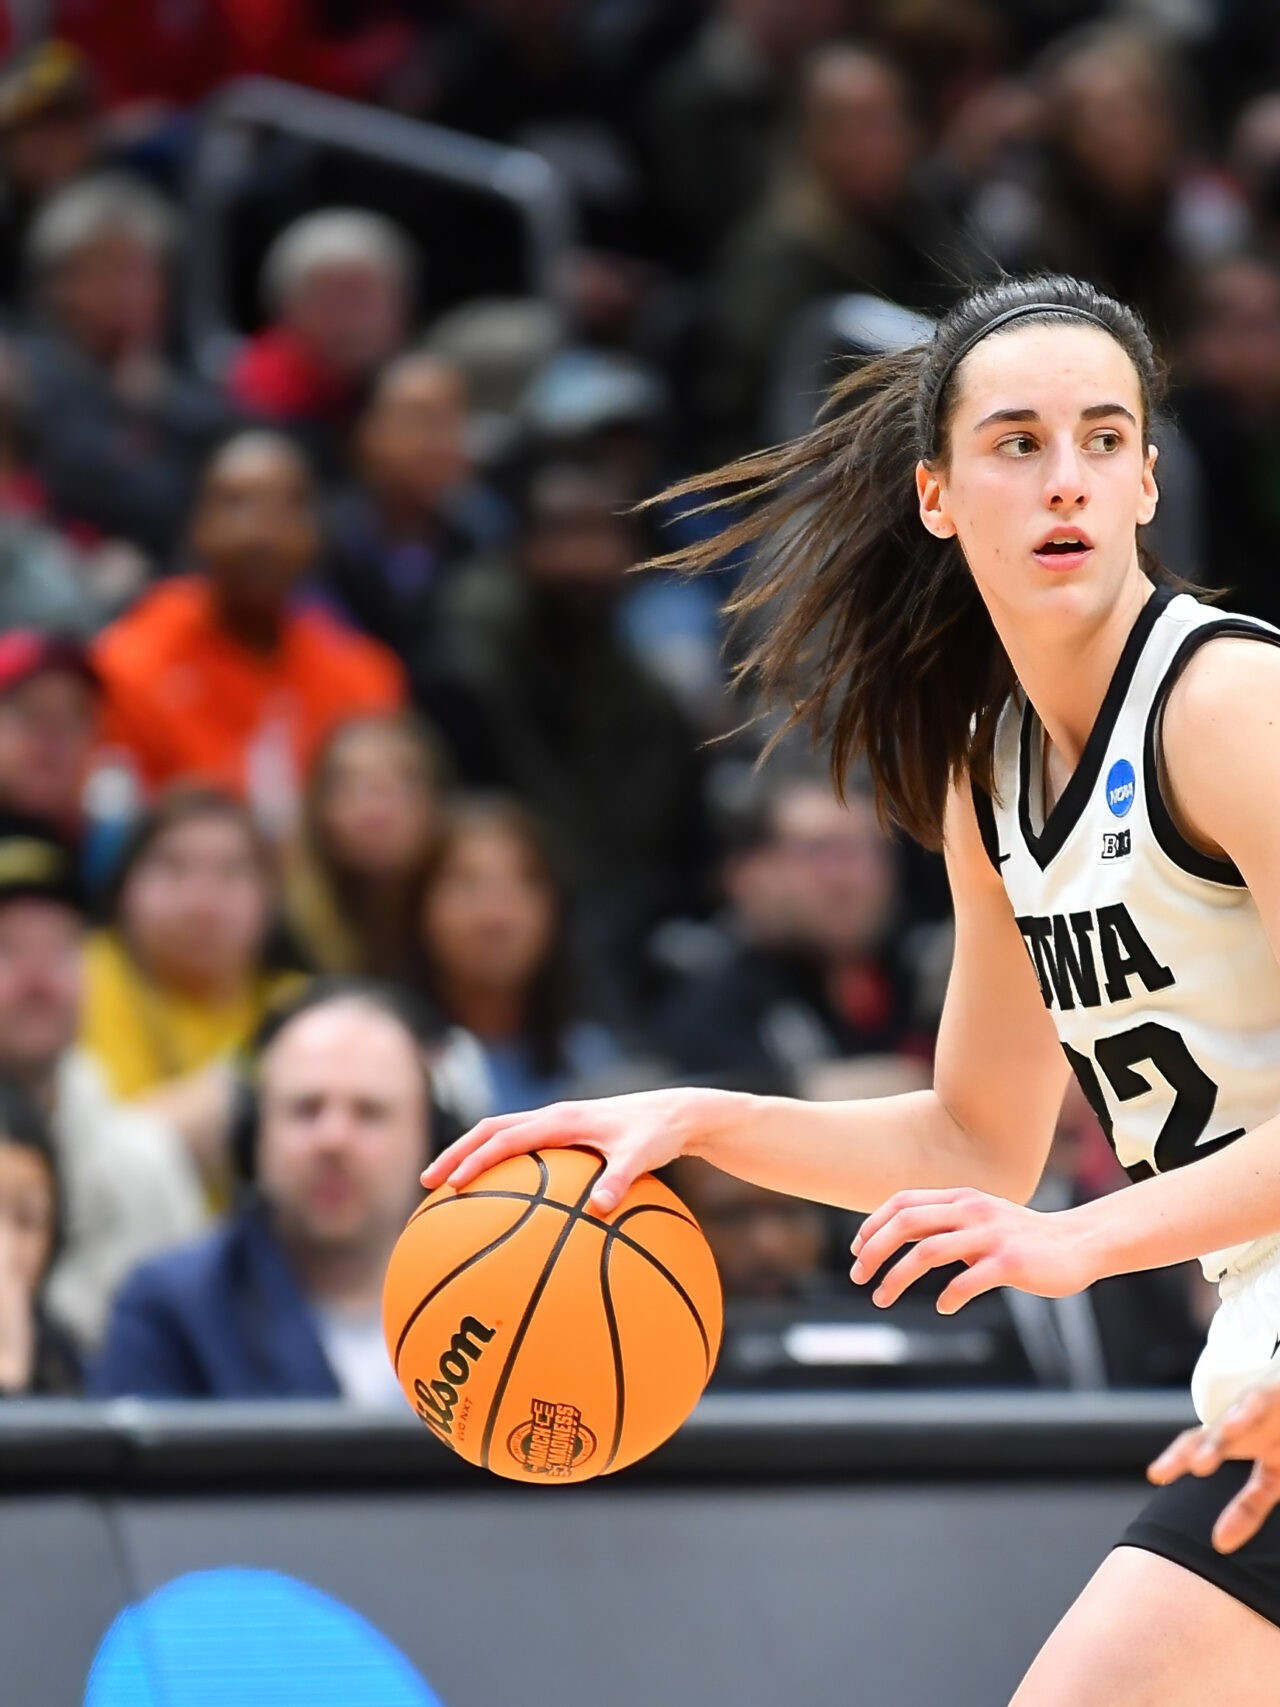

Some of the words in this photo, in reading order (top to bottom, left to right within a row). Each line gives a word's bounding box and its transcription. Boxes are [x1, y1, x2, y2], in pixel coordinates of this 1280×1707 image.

[1109, 781, 1134, 806] NCAA
[414, 1315, 497, 1450] ilson
[525, 1426, 553, 1468] MARCH
[545, 1404, 576, 1467] MADNESS
